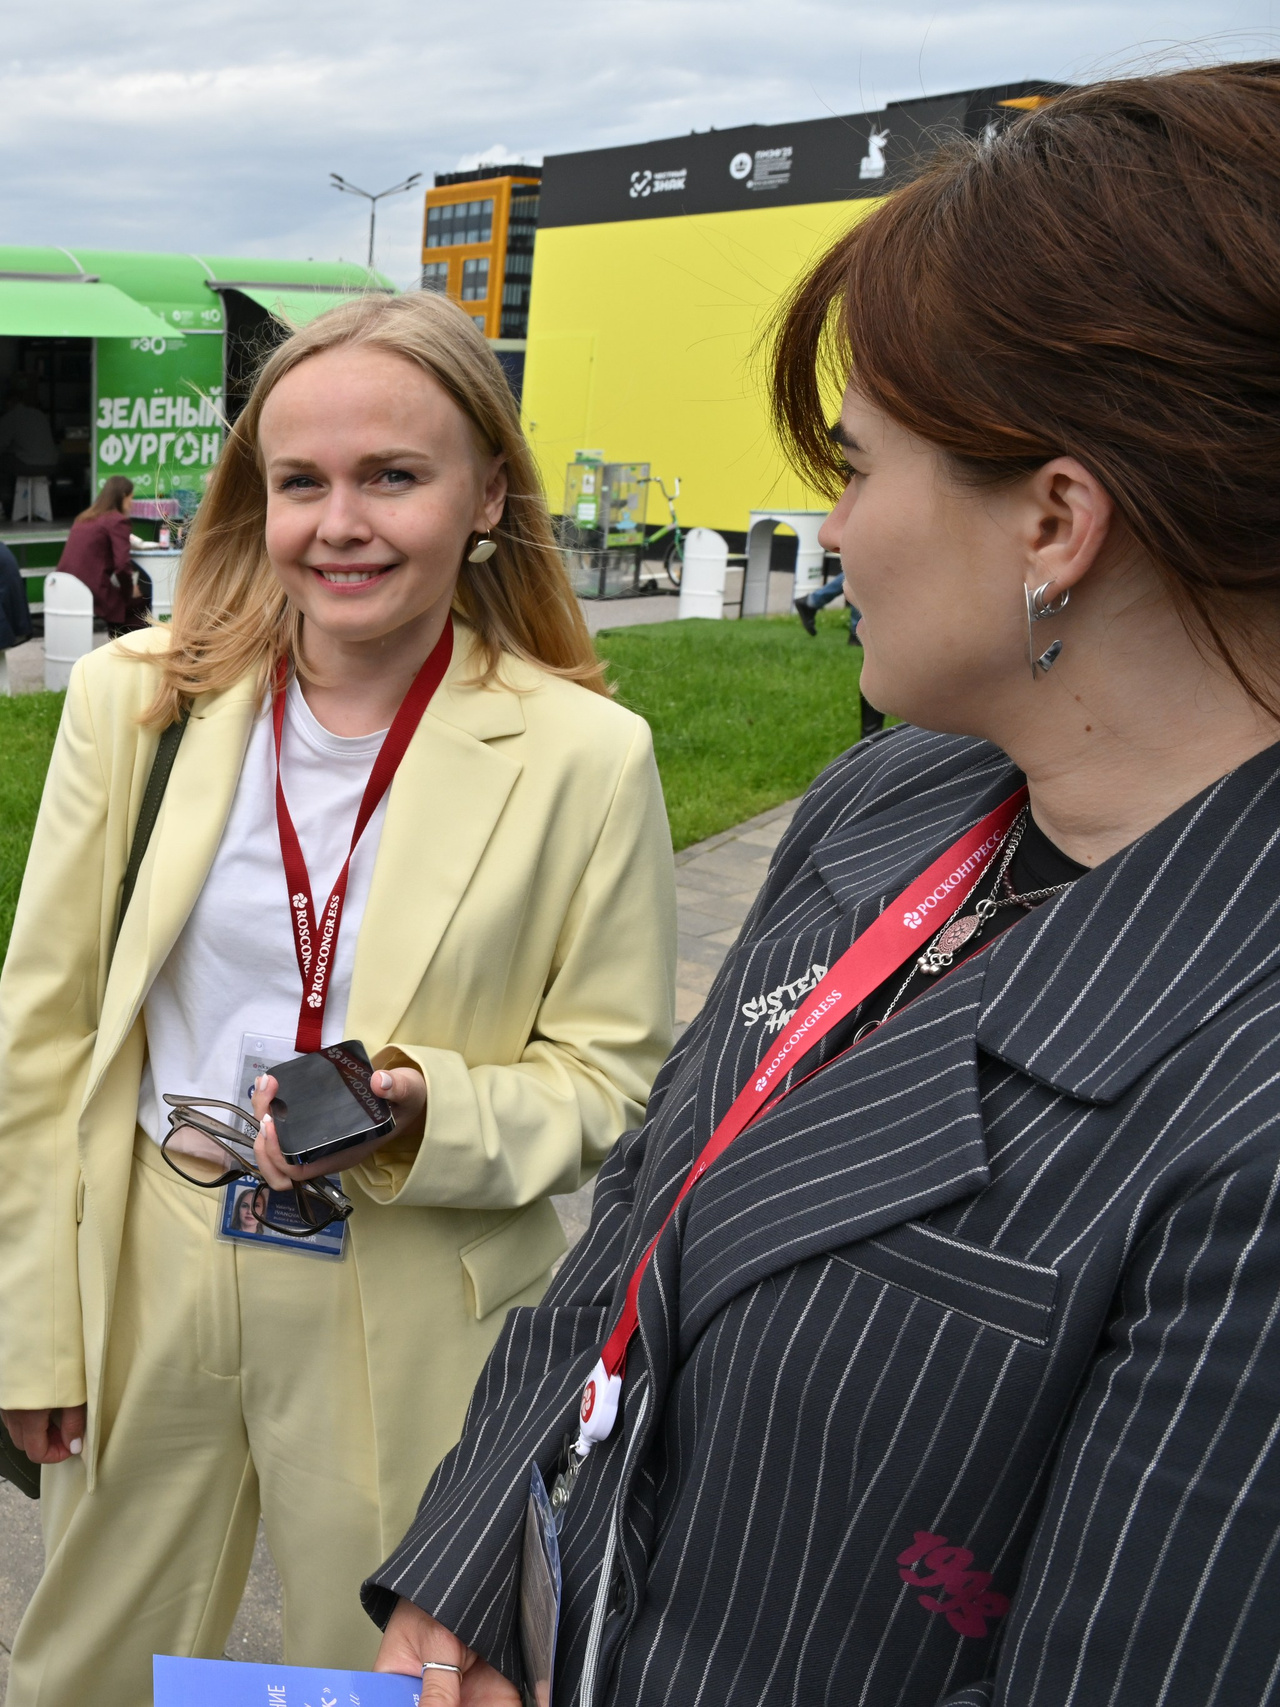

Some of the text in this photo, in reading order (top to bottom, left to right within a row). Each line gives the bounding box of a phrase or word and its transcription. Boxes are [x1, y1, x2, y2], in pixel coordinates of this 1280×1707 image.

[652, 178, 686, 193] ЗНАК
[96, 386, 222, 429] ЗЕЛЁНЫЙ
[100, 431, 219, 466] ФУРГОН
[917, 829, 1003, 916] РОСКОНГРЕСС
[312, 894, 340, 992] ROSCONGRESS
[766, 989, 842, 1077] ROSCONGRESS
